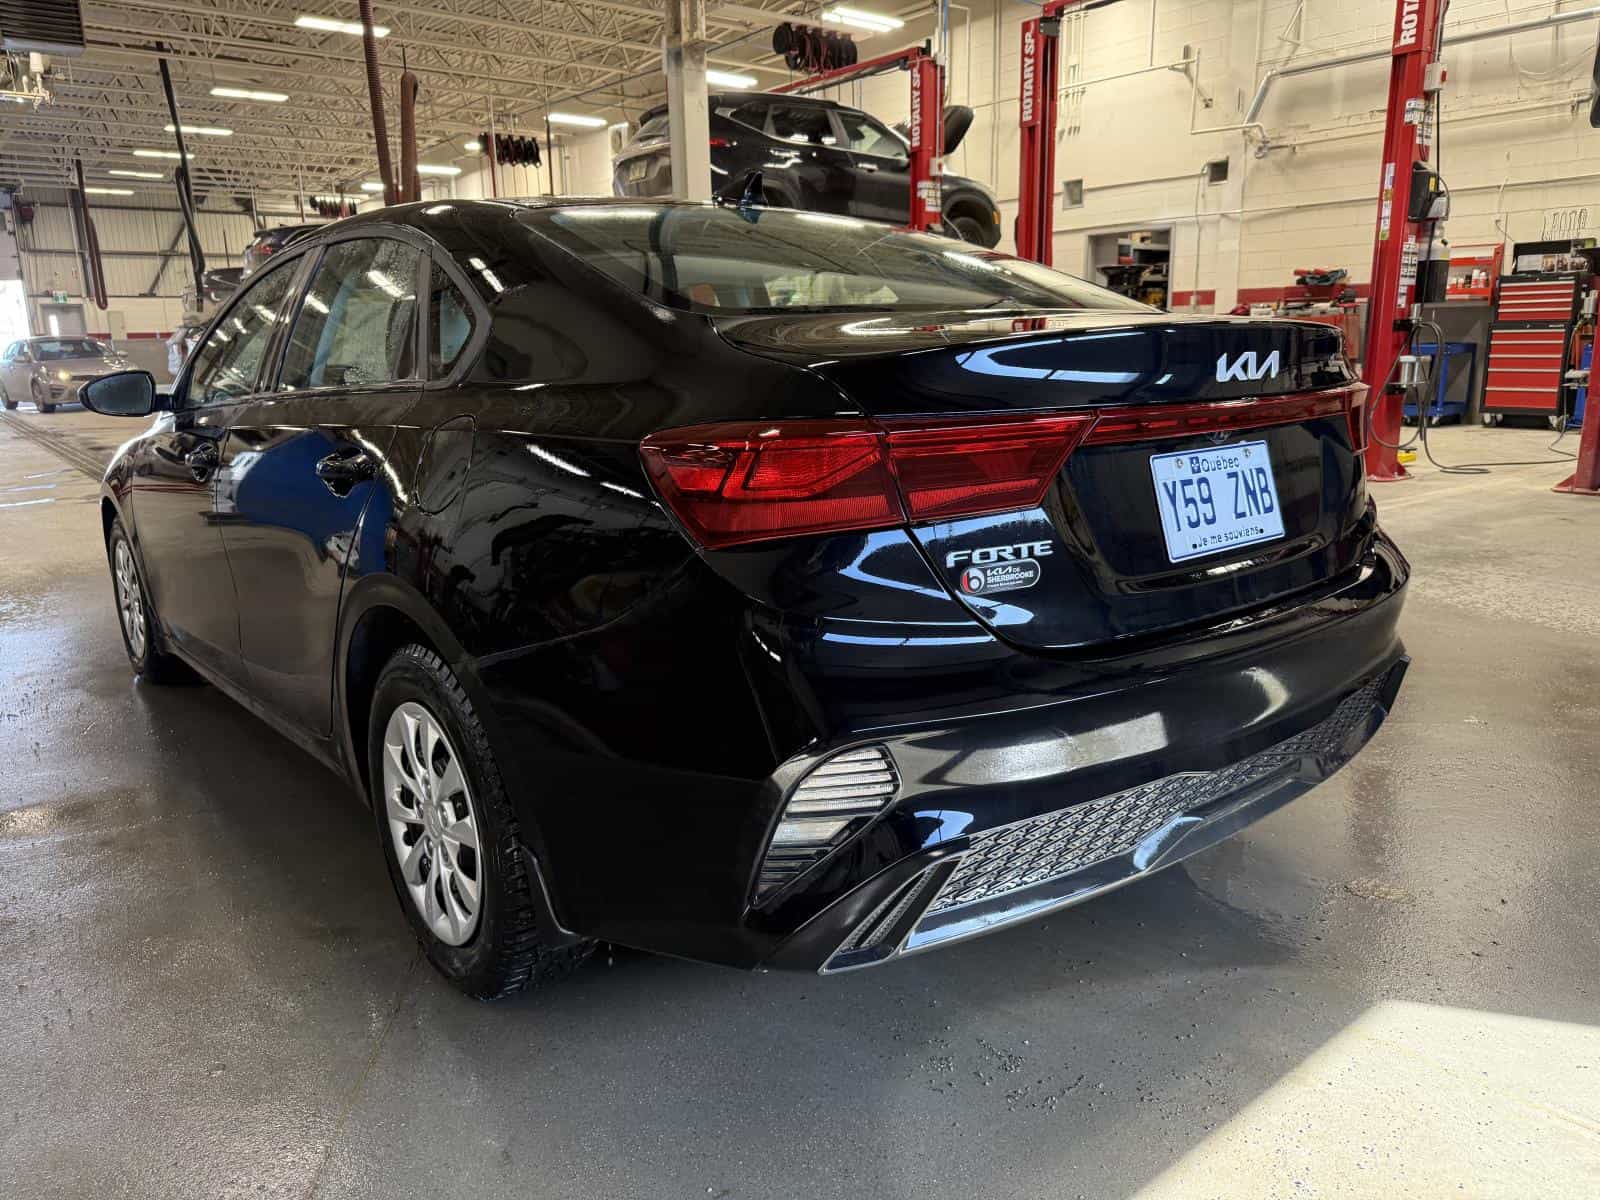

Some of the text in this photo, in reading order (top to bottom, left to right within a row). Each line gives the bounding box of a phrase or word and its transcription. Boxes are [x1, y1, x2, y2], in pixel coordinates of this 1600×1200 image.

[1399, 0, 1420, 46] ROT
[1022, 57, 1034, 122] ROTARY
[911, 90, 921, 147] ROTARY
[1216, 350, 1279, 382] KIA
[1201, 456, 1240, 472] Québec
[1163, 467, 1274, 532] Y59 ZNB
[1210, 534, 1222, 545] me
[1224, 526, 1259, 541] souviens
[946, 540, 1054, 568] FORTE
[986, 566, 1013, 577] KIA
